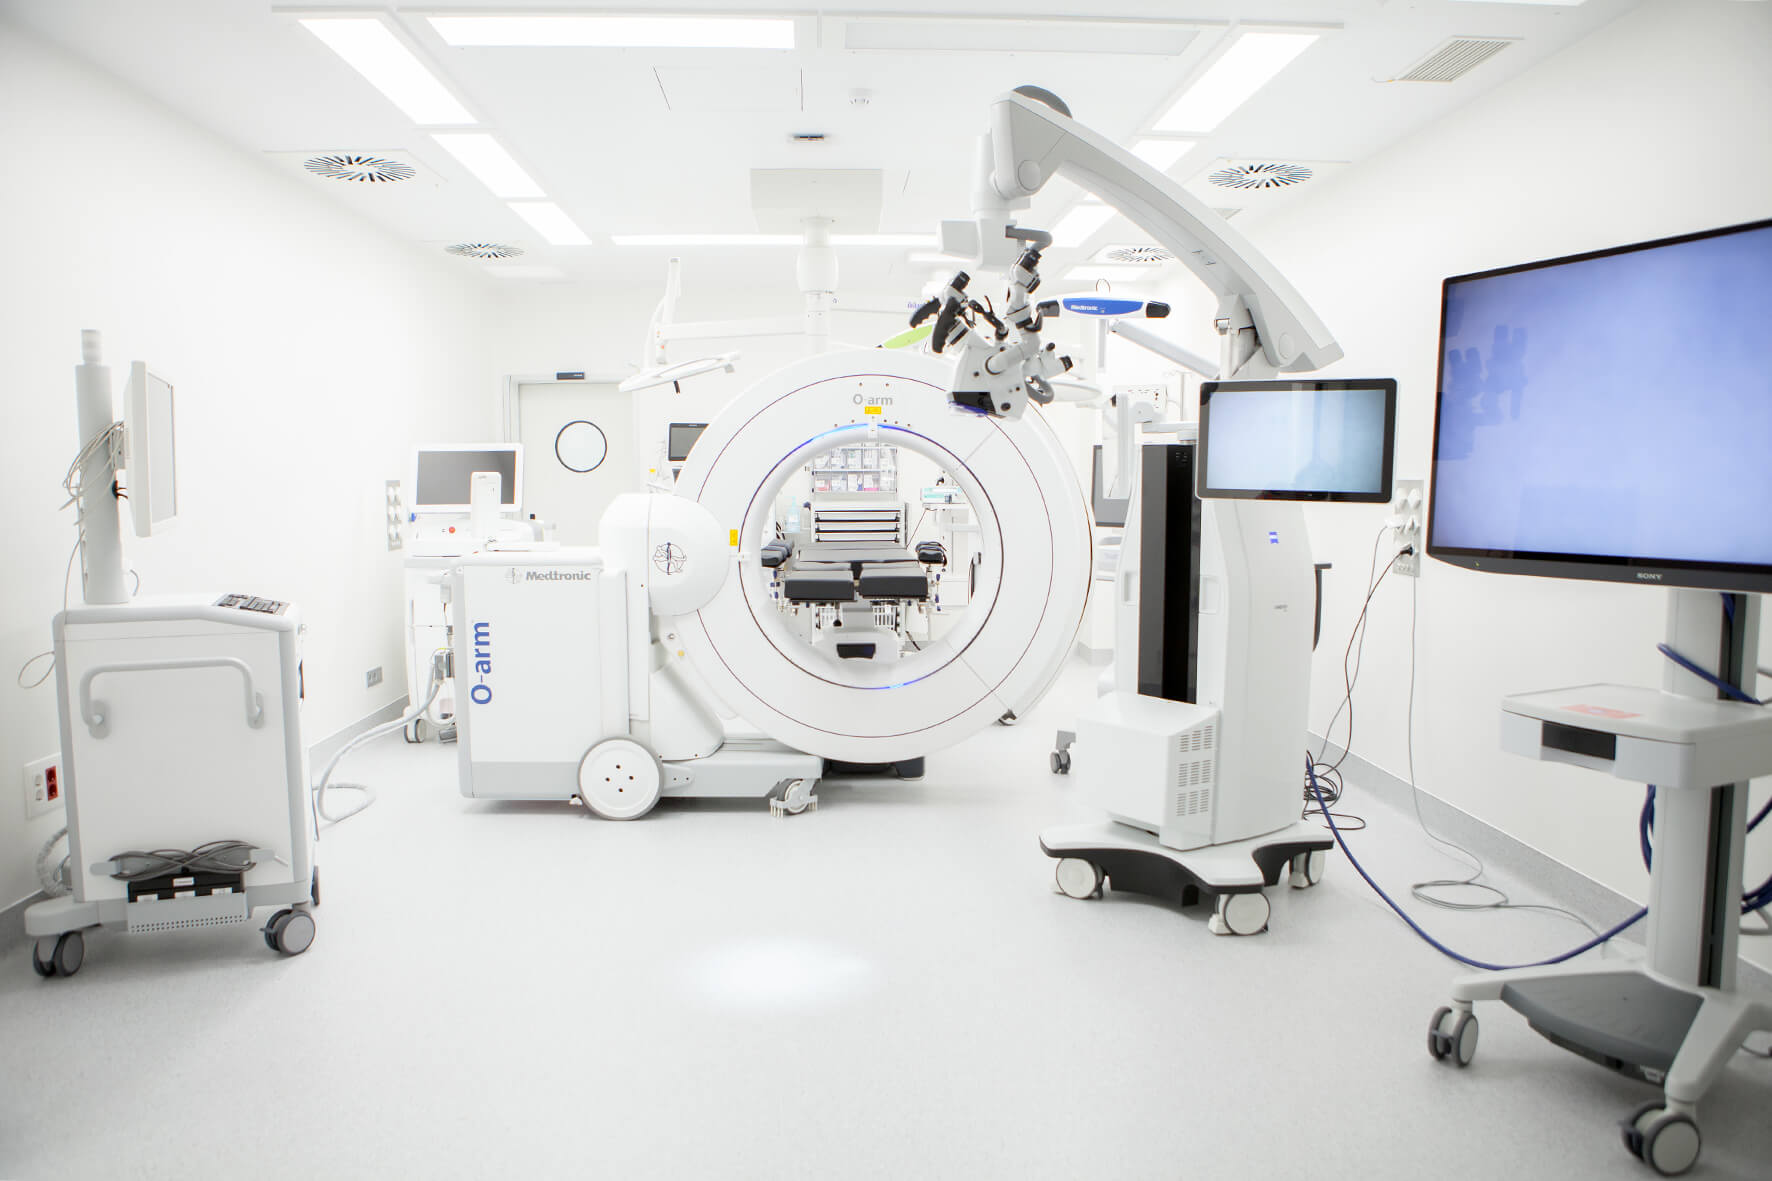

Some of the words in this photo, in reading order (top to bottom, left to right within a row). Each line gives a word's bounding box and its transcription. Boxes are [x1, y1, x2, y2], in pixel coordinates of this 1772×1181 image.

[526, 570, 591, 581] Medtronic
[1636, 572, 1662, 580] SONY
[470, 622, 492, 704] O-arm
